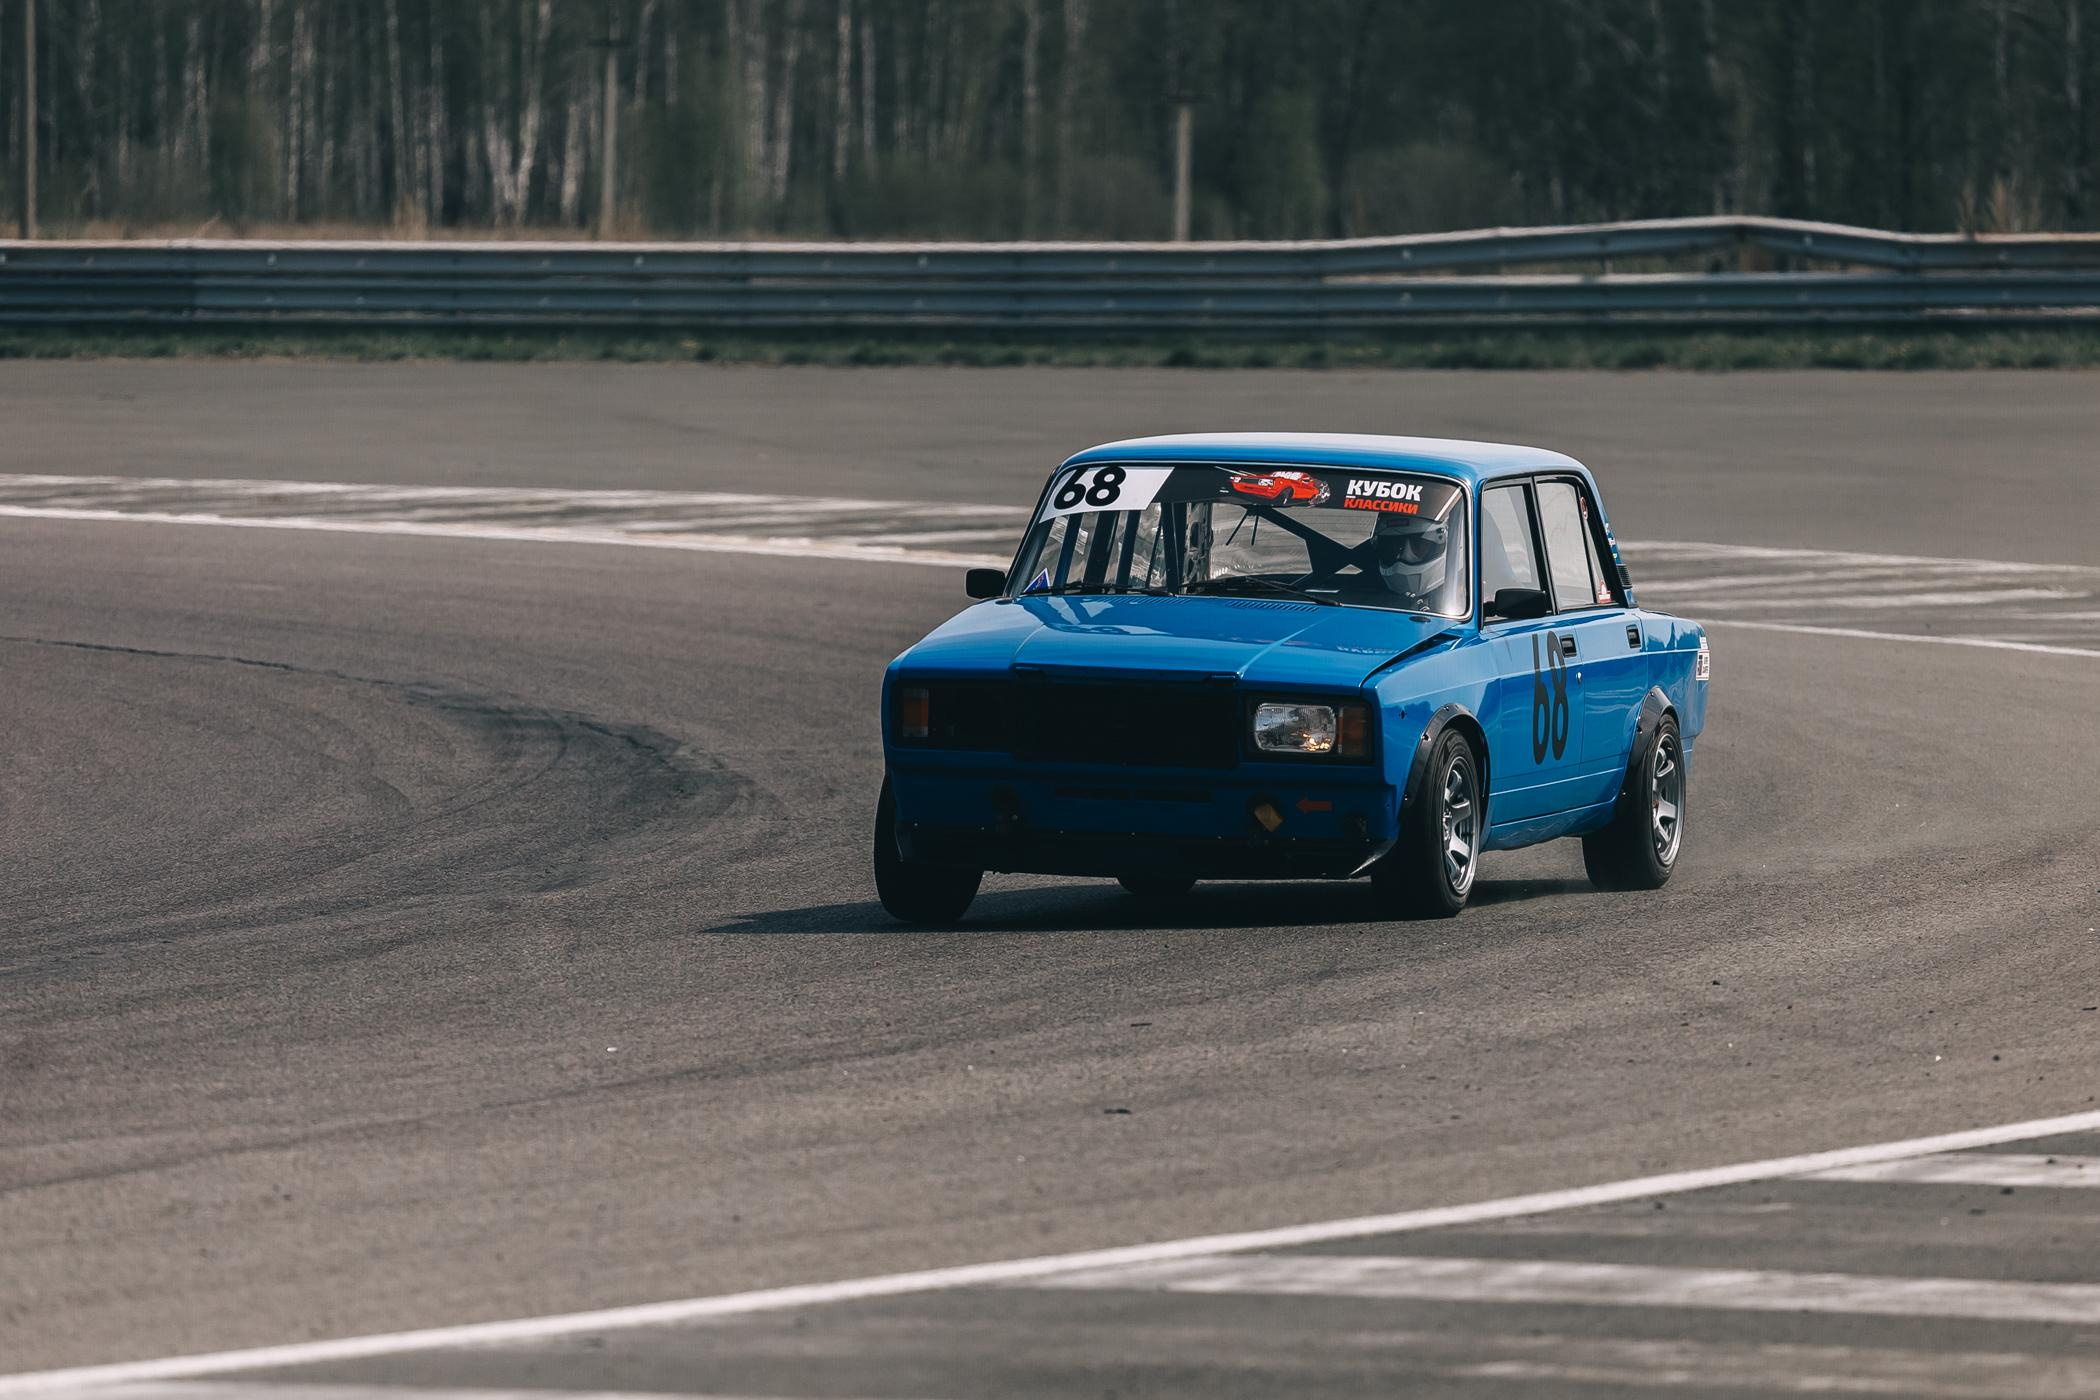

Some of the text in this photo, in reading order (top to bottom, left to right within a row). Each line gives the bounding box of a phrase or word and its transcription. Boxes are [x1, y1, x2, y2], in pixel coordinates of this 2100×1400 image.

[1053, 466, 1126, 510] 68
[1347, 479, 1423, 501] КУБОК
[1344, 498, 1419, 514] КЛАССИКИ
[1532, 631, 1568, 765] 68
